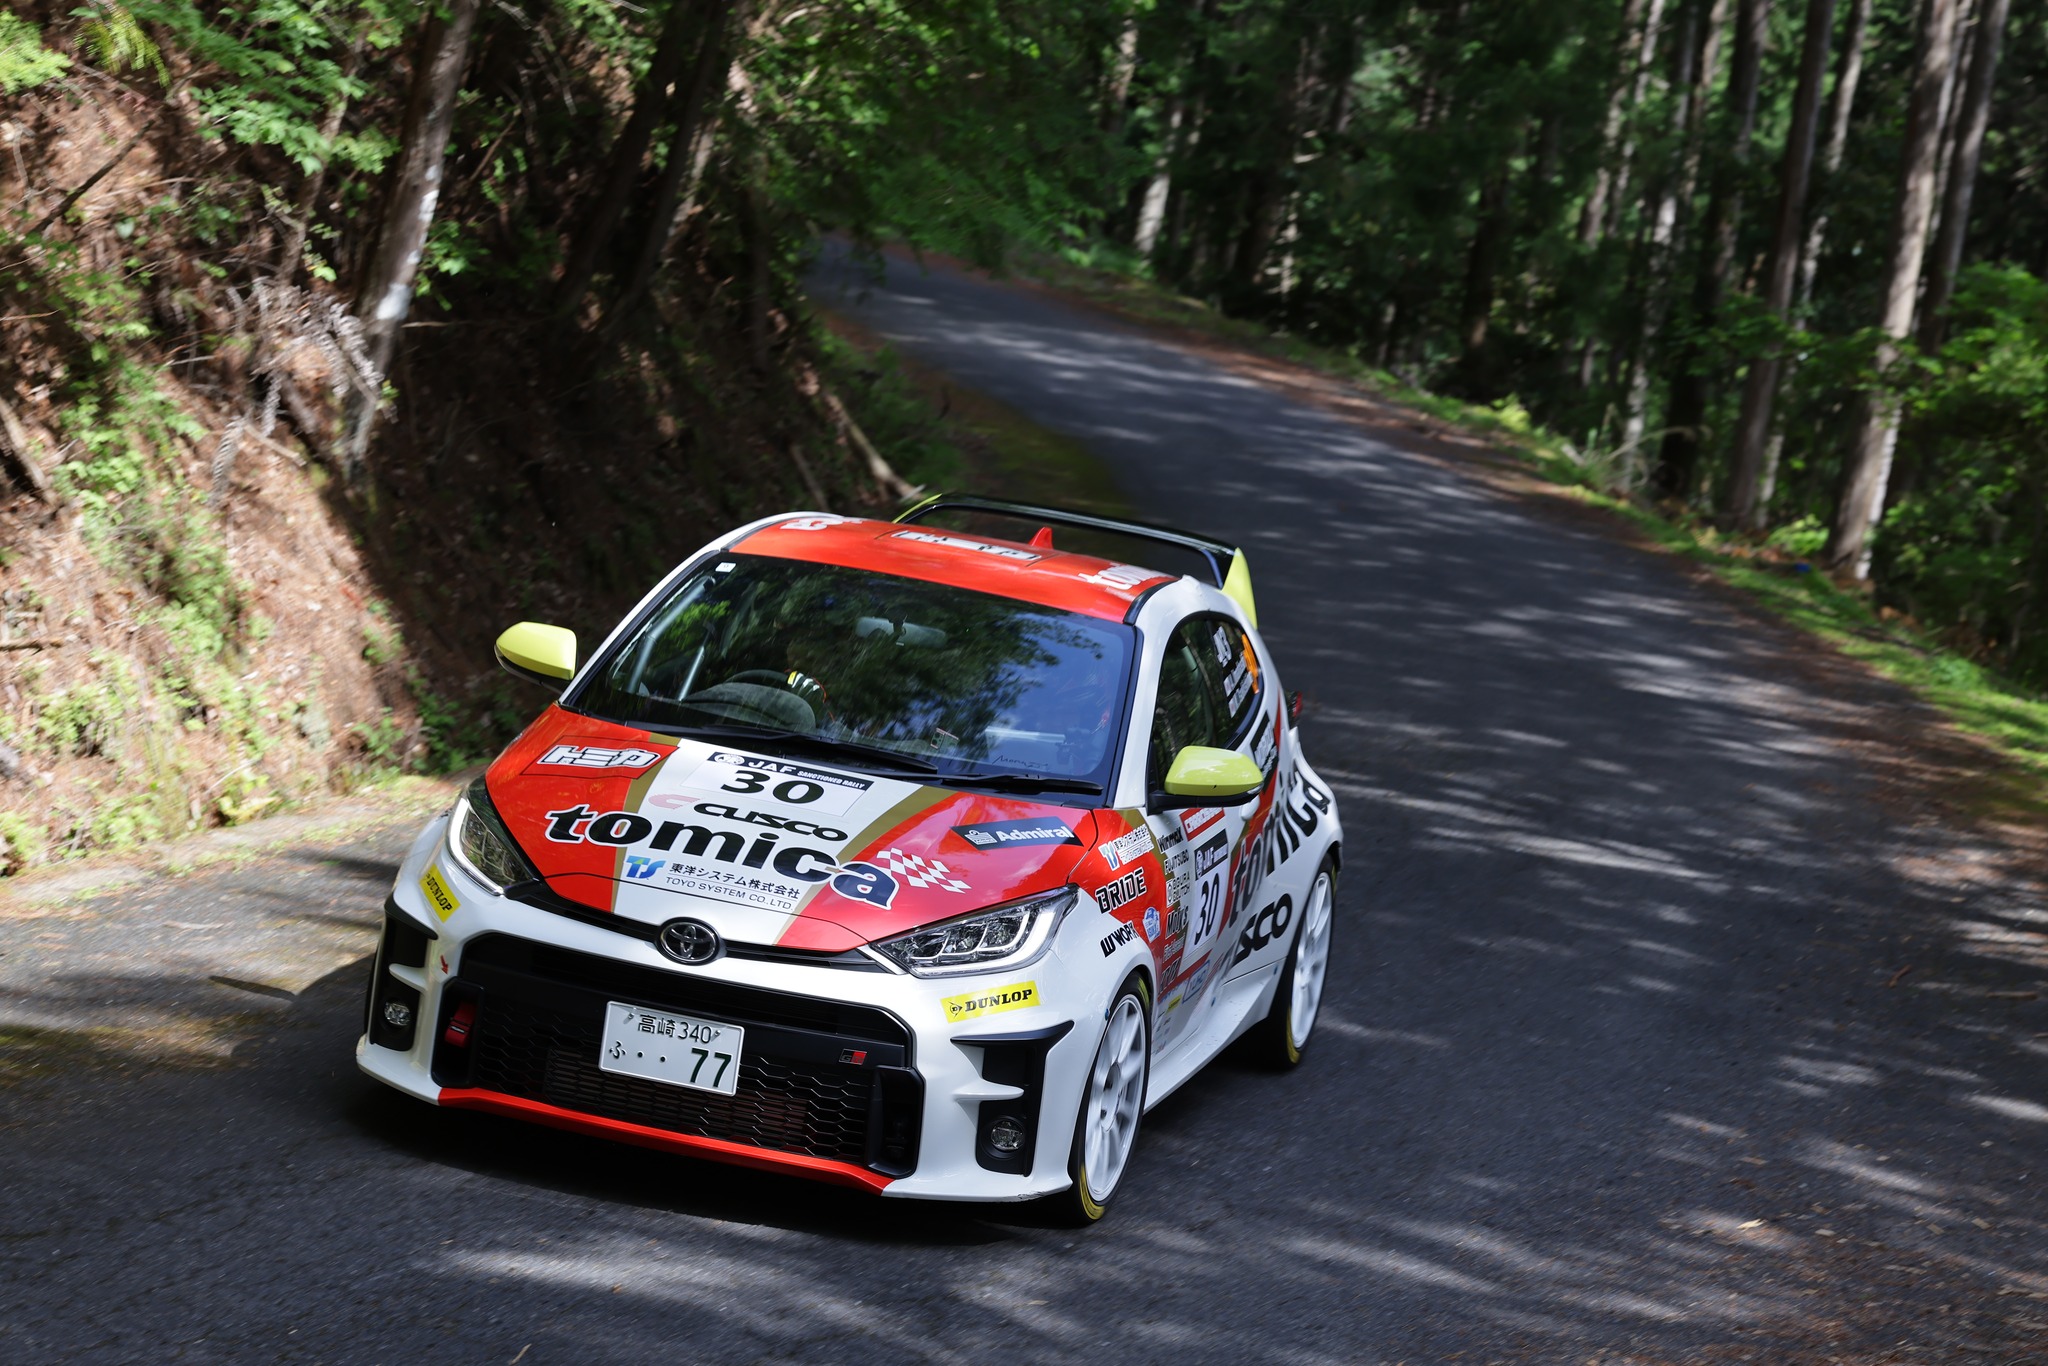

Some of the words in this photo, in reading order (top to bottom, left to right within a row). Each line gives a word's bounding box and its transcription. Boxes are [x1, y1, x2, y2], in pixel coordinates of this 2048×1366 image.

[538, 745, 661, 768] トミカ
[720, 769, 825, 804] 30
[748, 760, 797, 774] JAF
[797, 770, 843, 785] SANCTIONED
[841, 780, 865, 790] RALLY
[996, 826, 1075, 842] Admiral
[546, 804, 899, 909] tomica
[426, 876, 453, 911] DUNLOP
[666, 876, 696, 889] TOYO
[698, 883, 746, 899] SYSTEM
[669, 862, 801, 900] 東洋システム株式会社
[1095, 868, 1147, 914] BRIDE
[1194, 873, 1220, 946] 30
[965, 988, 1032, 1012] DUNLOP
